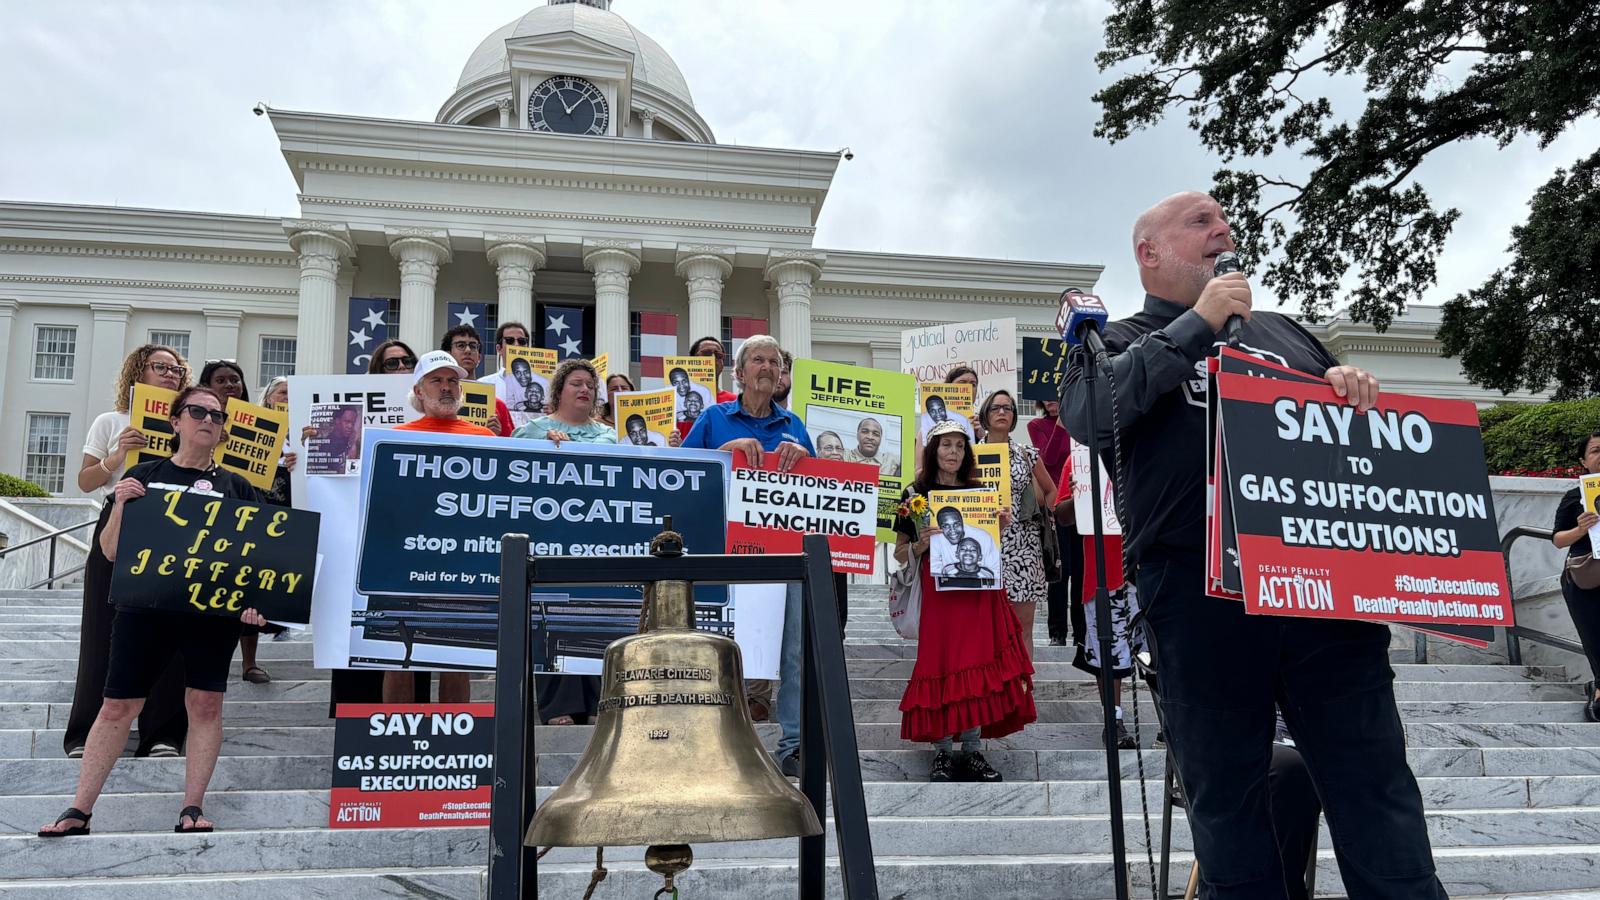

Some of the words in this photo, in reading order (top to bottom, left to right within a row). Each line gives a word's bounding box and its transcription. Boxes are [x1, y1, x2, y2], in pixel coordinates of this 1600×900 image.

[1071, 296, 1101, 307] 12
[955, 321, 999, 344] override
[946, 346, 958, 359] IS
[810, 374, 872, 398] LIFE
[145, 398, 169, 416] LIFE
[645, 397, 660, 405] VOTED
[811, 393, 860, 408] JEFFERY
[865, 400, 886, 409] LEE
[233, 410, 254, 427] LIFE
[380, 415, 405, 424] LEE
[471, 406, 488, 419] FOR
[1273, 399, 1354, 447] SAY
[1366, 410, 1434, 454] NO
[256, 432, 276, 448] FOR
[225, 440, 271, 462] JEFFERY
[250, 462, 268, 476] LEE
[392, 452, 498, 482] THOU
[507, 460, 623, 488] SHALT
[633, 467, 707, 491] NOT
[983, 467, 1001, 478] FOR
[1346, 456, 1373, 476] TO
[735, 469, 838, 490] EXECUTIONS
[842, 482, 874, 495] ARE
[741, 486, 866, 514] LEGALIZED
[945, 495, 960, 503] JURY
[1239, 474, 1296, 505] GAS
[1301, 479, 1487, 519] SUFFOCATION
[163, 490, 289, 538] LIFE
[434, 491, 665, 525] SUFFOCATE.
[744, 510, 861, 537] LYNCHING
[187, 529, 257, 557] for
[403, 534, 458, 555] stop
[1280, 516, 1459, 556] EXECUTIONS!
[130, 548, 303, 594] JEFFERY
[409, 571, 436, 582] Paid
[439, 571, 458, 582] for
[461, 572, 476, 585] by
[1258, 564, 1287, 574] DEATH
[1290, 566, 1331, 577] PENALTY
[1258, 574, 1334, 611] ACTION
[1394, 574, 1500, 597] #StopExecutions
[188, 582, 245, 612] LEE
[1353, 595, 1503, 620] DeathPenaltyAction.org
[616, 668, 665, 683] DELAWARE
[666, 668, 712, 680] CITIZENS
[624, 696, 637, 706] TO
[638, 694, 658, 705] THE
[661, 693, 696, 704] DEATH
[369, 713, 424, 736] SAY
[430, 713, 475, 736] NO
[649, 729, 669, 739] 1992
[412, 740, 430, 751] TO
[337, 755, 375, 771] GAS
[360, 774, 478, 792] EXECUTIONS!
[336, 806, 381, 822] ACTION
[442, 801, 491, 810] #StopExecutio
[419, 812, 491, 820] DeathPenaltyAction.
